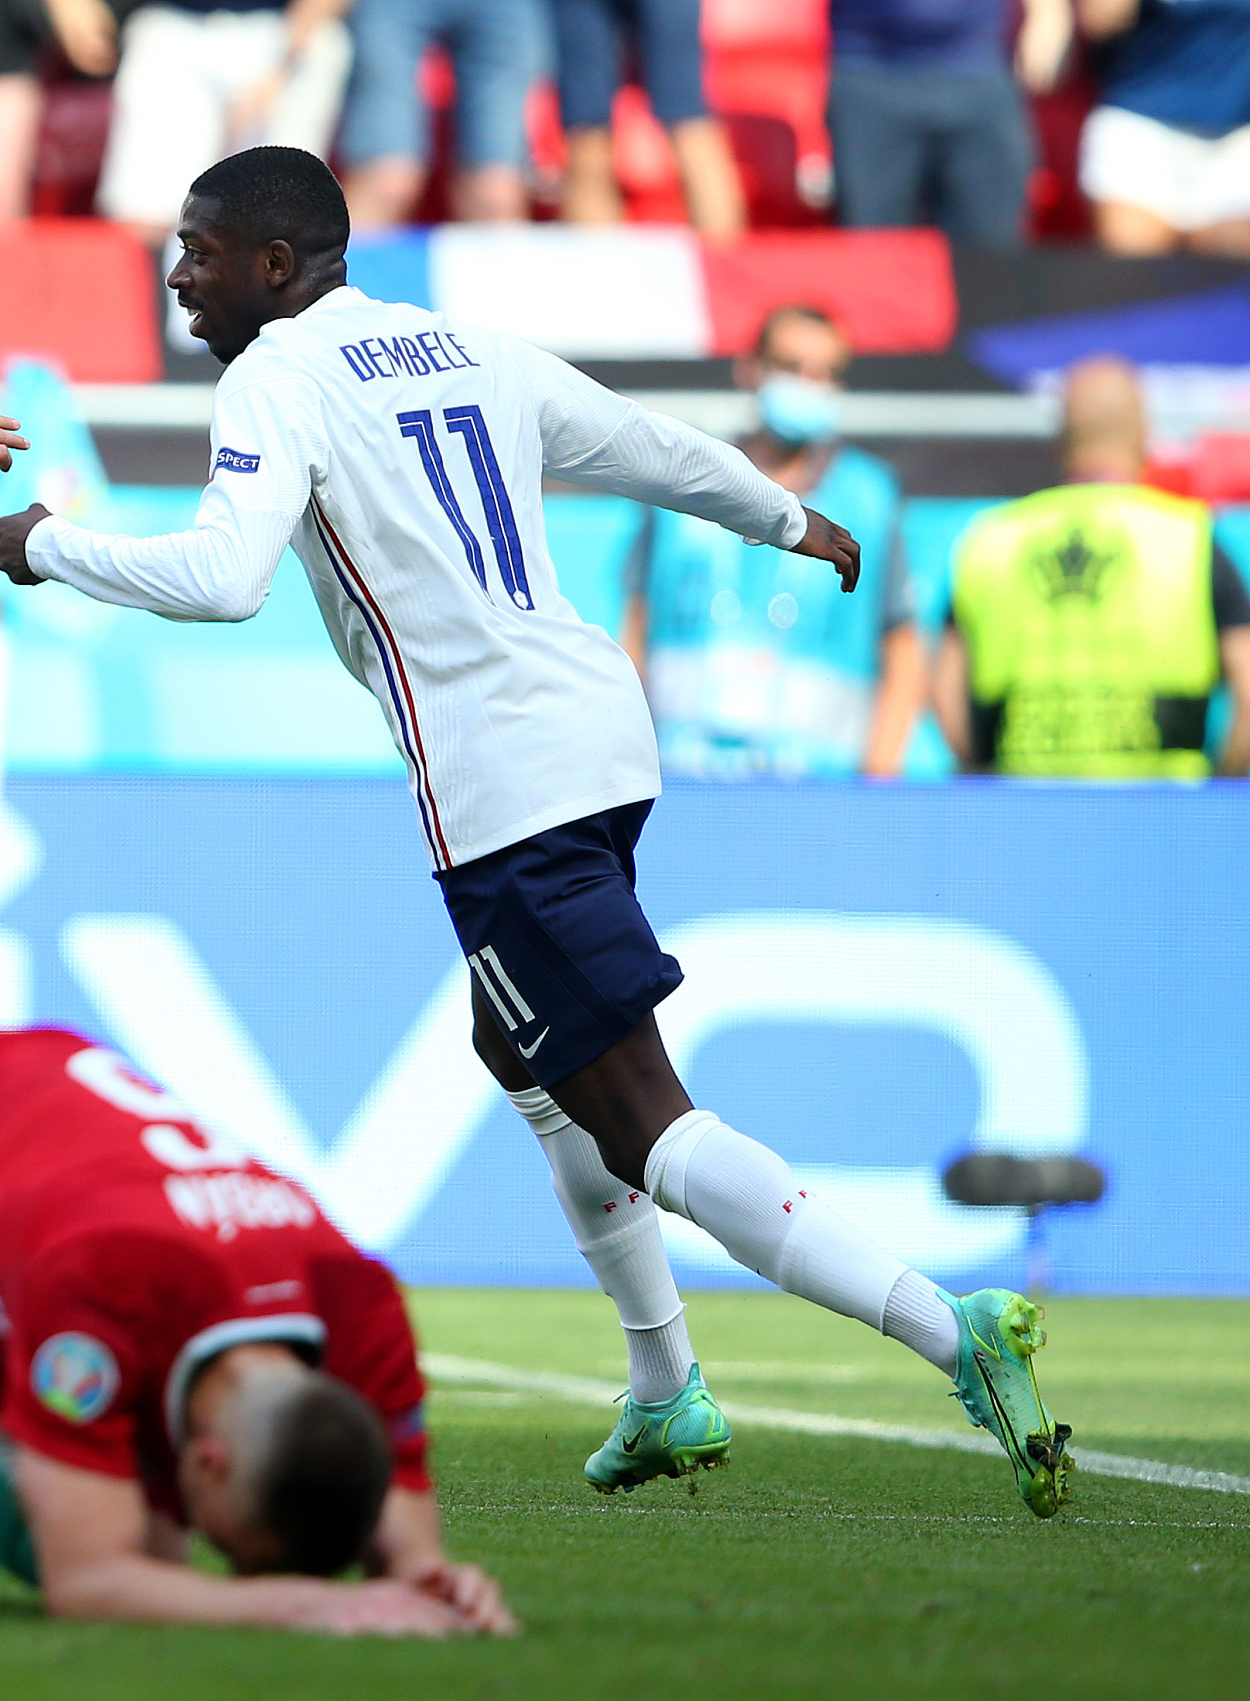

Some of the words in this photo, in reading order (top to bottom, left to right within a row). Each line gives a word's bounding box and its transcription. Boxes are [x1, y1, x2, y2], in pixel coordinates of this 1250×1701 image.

[338, 331, 481, 383] DEMBELE
[395, 404, 536, 611] 11
[467, 944, 536, 1032] 11
